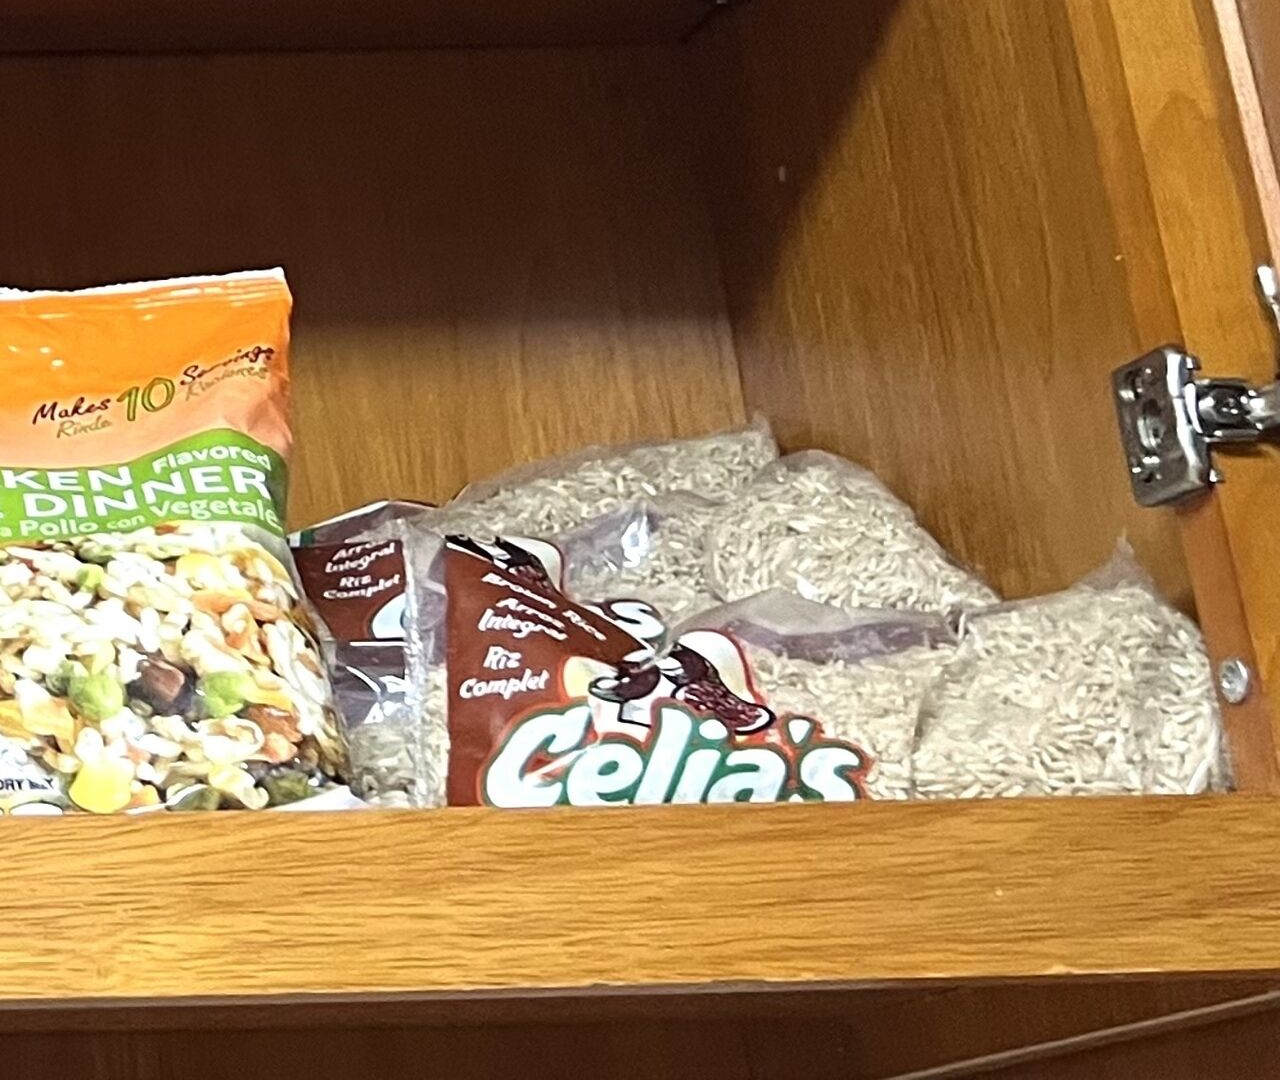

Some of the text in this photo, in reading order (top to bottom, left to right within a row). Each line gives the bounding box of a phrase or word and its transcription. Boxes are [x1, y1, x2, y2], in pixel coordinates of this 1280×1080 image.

[32, 345, 274, 425] Makes 10 Servings
[152, 445, 271, 475] Flavored
[23, 466, 271, 519] DINNER
[0, 526, 13, 538] a
[20, 518, 99, 538] Pollo
[106, 514, 146, 532] con
[325, 542, 395, 573] Integral
[323, 574, 401, 599] Complet
[483, 645, 523, 670] Riz
[459, 668, 551, 700] Complet
[483, 703, 860, 805] Celia's
